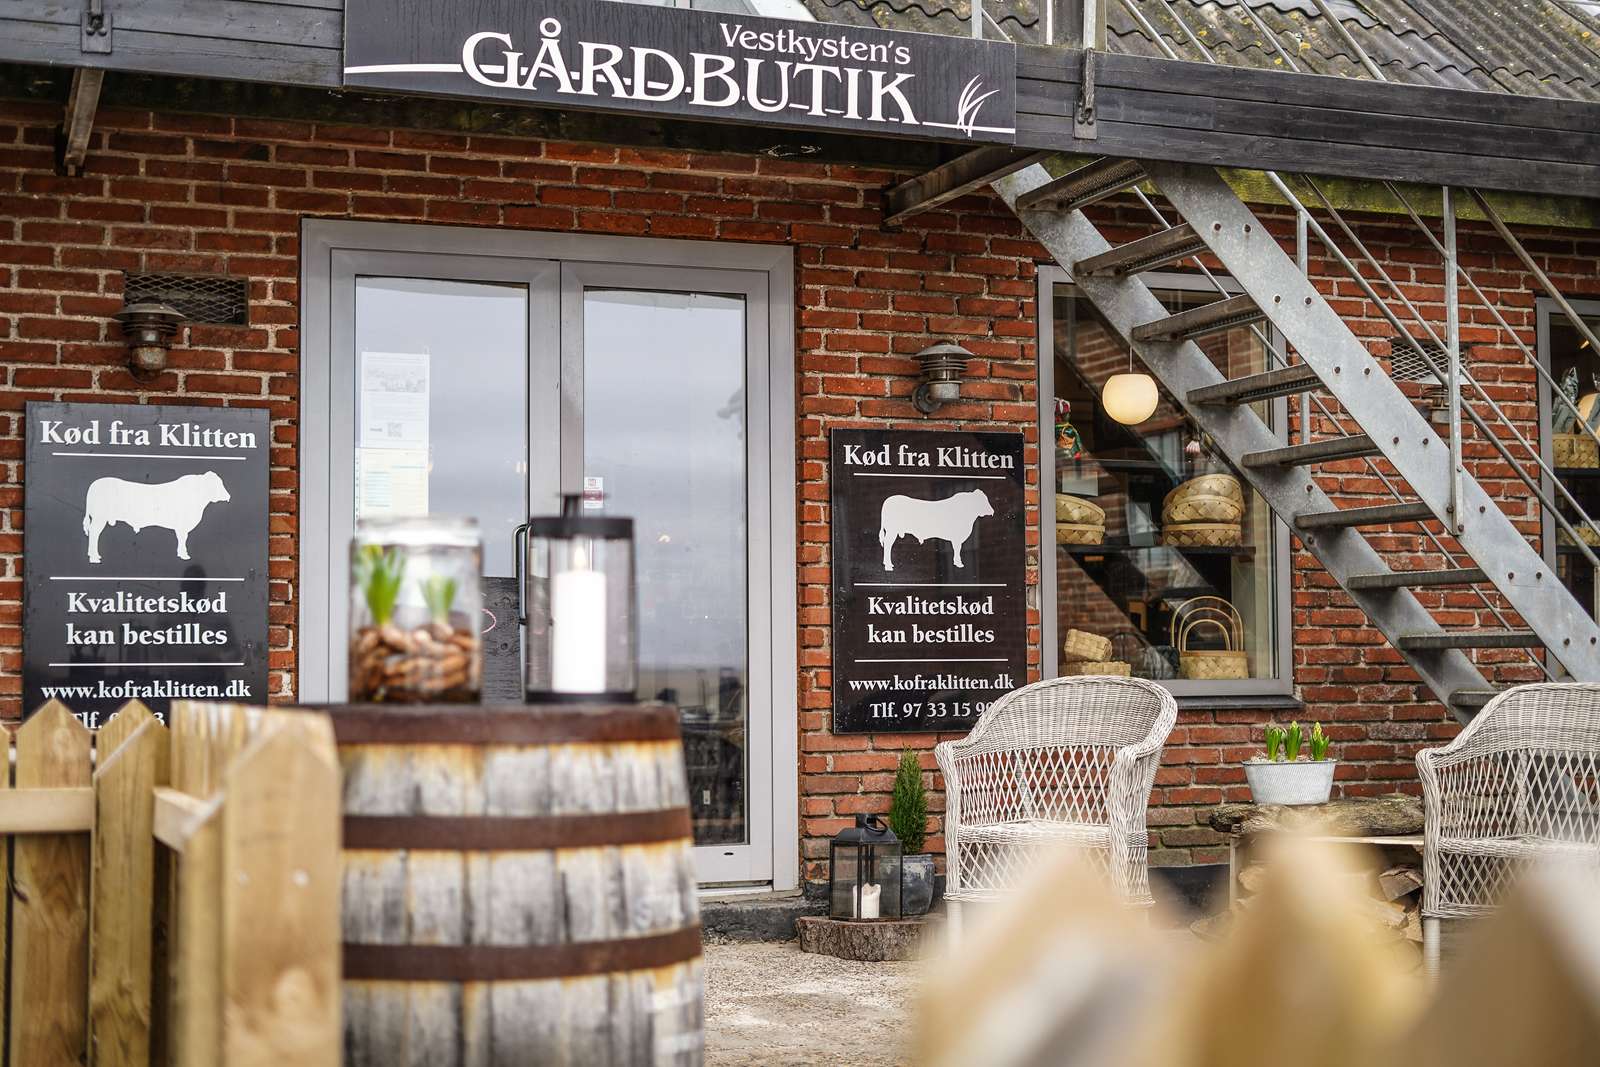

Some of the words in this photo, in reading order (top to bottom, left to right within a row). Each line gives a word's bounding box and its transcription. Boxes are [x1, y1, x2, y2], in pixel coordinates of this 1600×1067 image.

[720, 22, 911, 65] Vestkysten's
[462, 18, 920, 124] GÅRDBUTIK
[40, 420, 99, 444] Kød
[109, 420, 150, 446] fra
[160, 423, 257, 448] Klitten
[844, 444, 891, 466] Kød
[898, 444, 930, 467] fra
[937, 446, 1014, 469] Klitten
[67, 592, 227, 613] Kvalitetskød
[868, 596, 994, 615] Kvalitetskød
[66, 624, 115, 645] kan
[122, 624, 228, 645] bestilles
[868, 624, 906, 643] kan
[912, 624, 994, 643] bestilles
[40, 680, 251, 699] www.kofraklitten.dk
[849, 674, 1015, 691] www.kofraklitten.dk
[870, 702, 898, 718] Tlf.
[903, 702, 922, 718] 97
[927, 702, 946, 717] 33
[953, 702, 970, 717] 15
